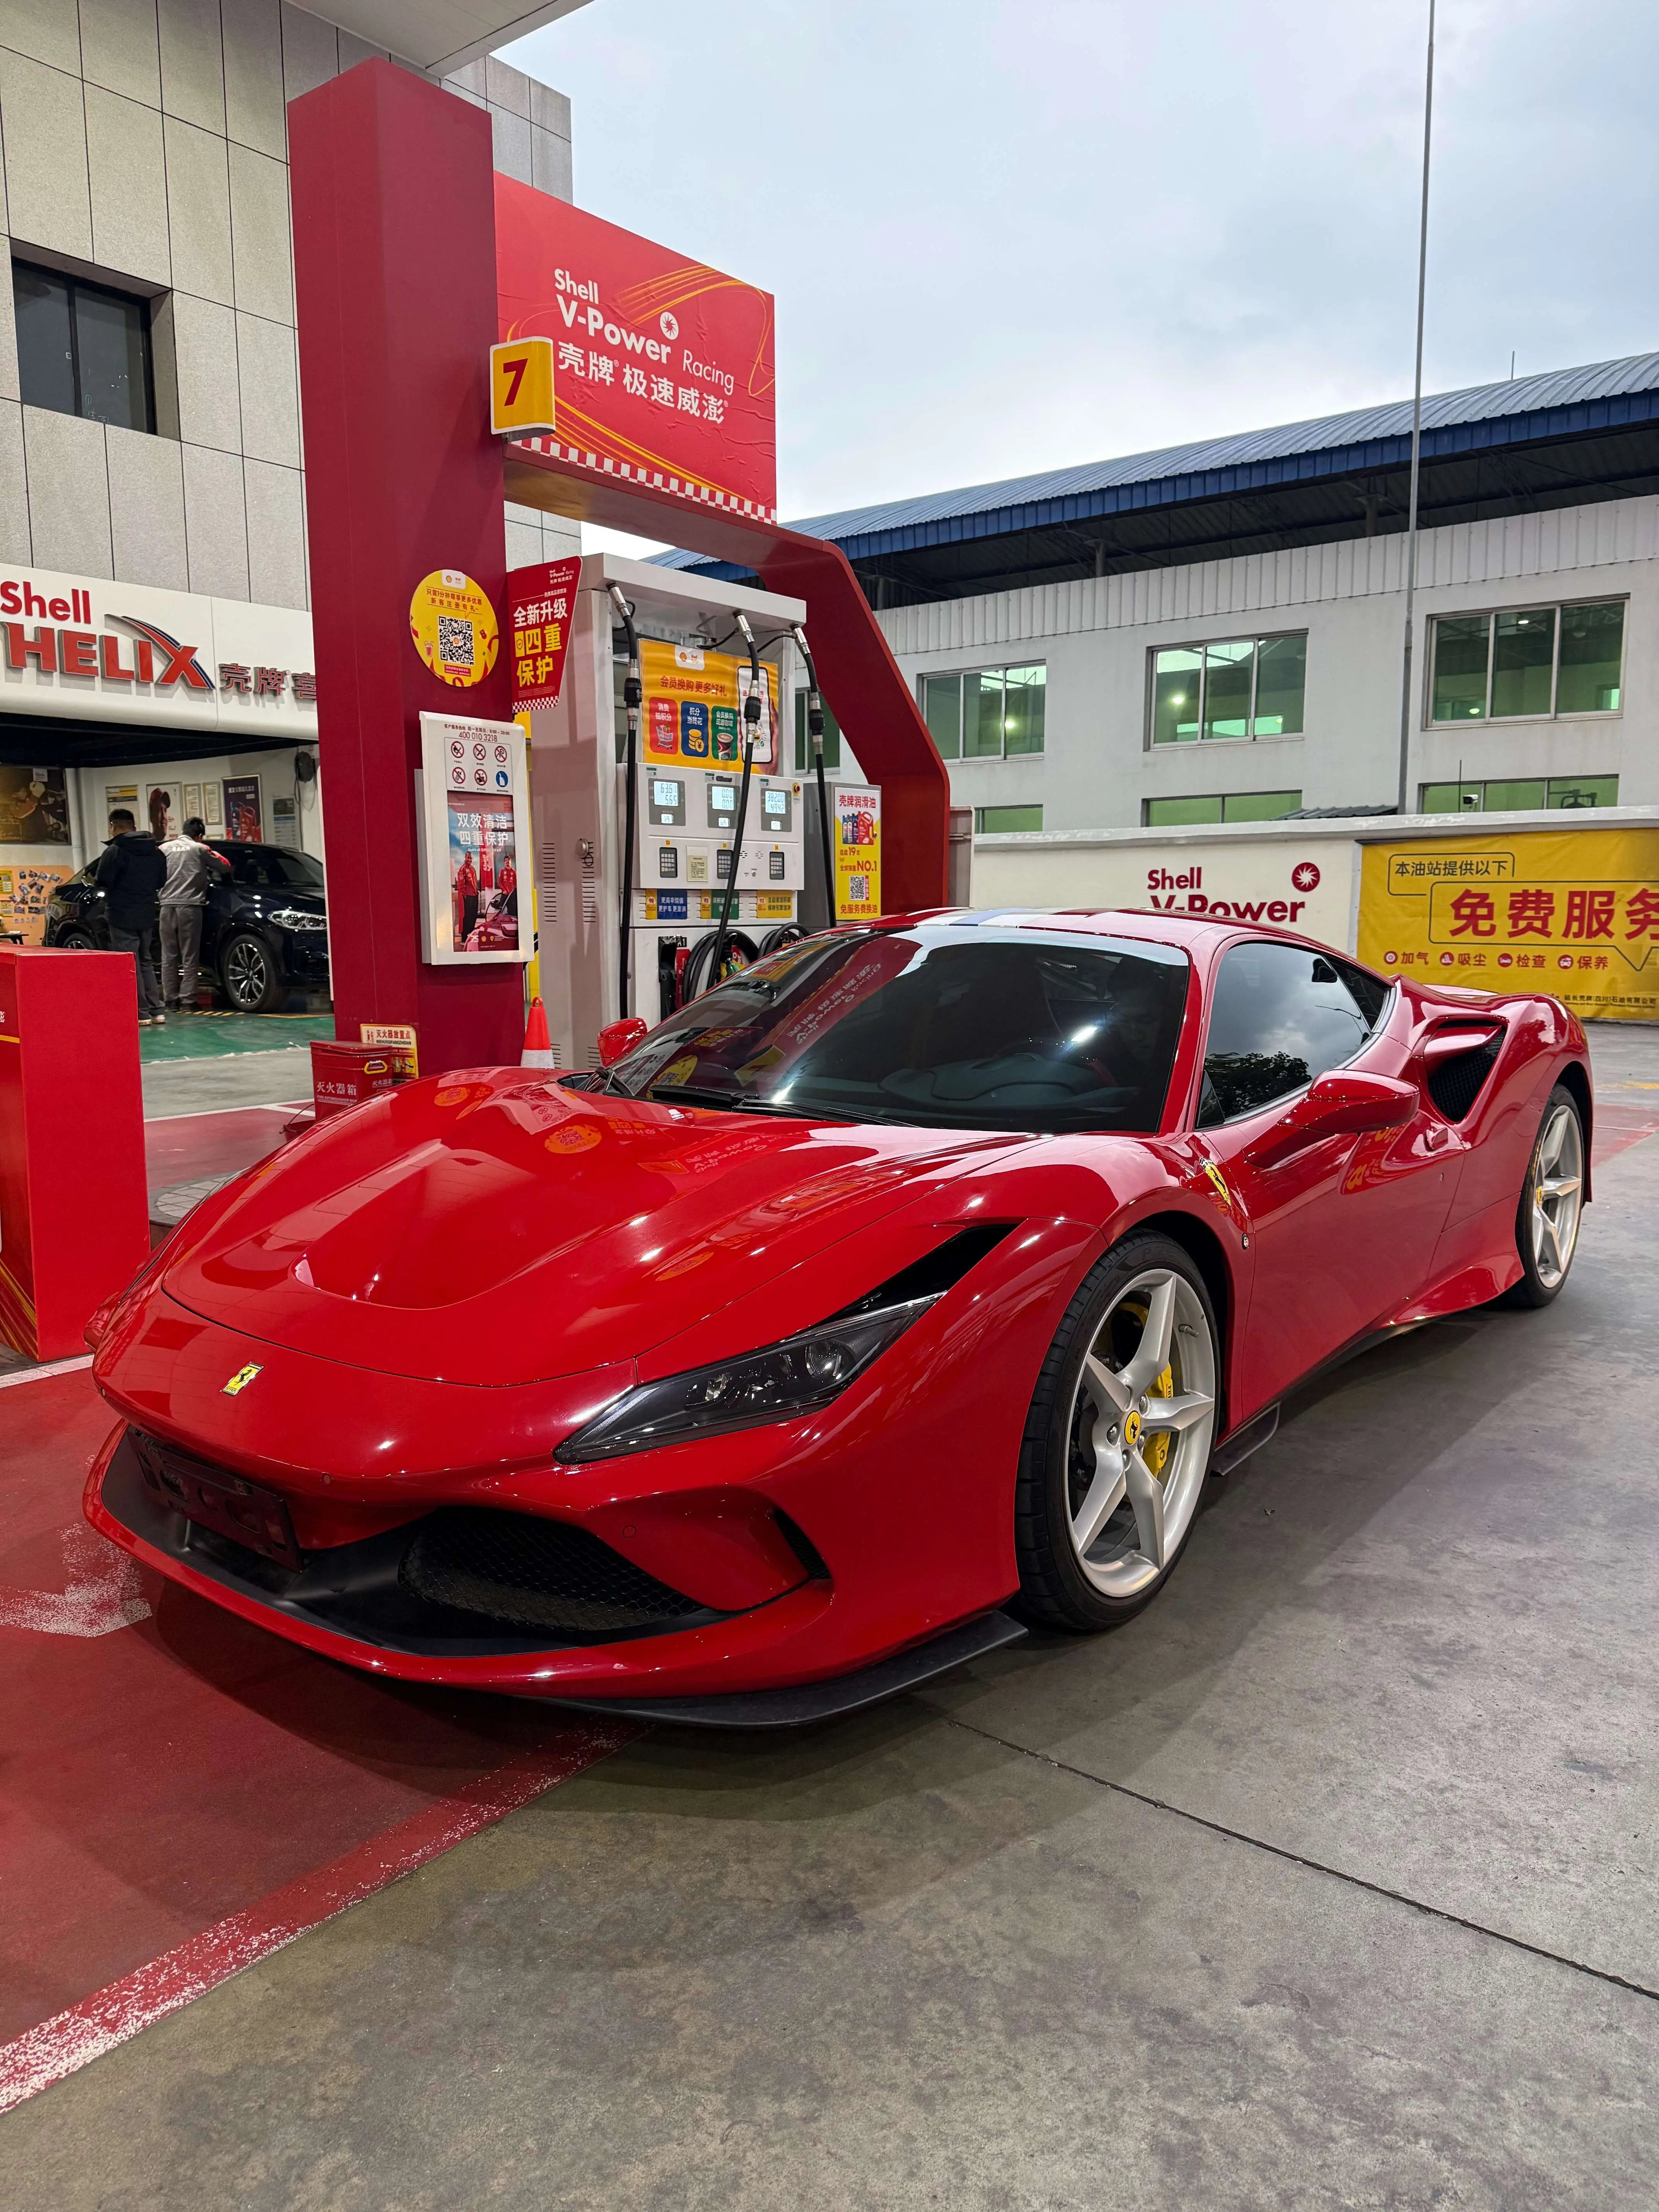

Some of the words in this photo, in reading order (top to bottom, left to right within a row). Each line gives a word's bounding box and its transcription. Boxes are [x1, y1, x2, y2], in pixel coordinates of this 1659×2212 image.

[554, 268, 598, 304] Shell
[556, 294, 672, 364] V-Power
[682, 350, 734, 395] Racing
[503, 358, 528, 406] 7
[0, 581, 91, 624] Shell
[513, 598, 568, 628] 全新升级
[526, 623, 562, 654] 四重
[2, 616, 216, 690] HELIX
[517, 656, 553, 687] 保护
[660, 675, 694, 692] 会员换购
[689, 707, 700, 716] 积分
[459, 731, 470, 739] 400
[484, 734, 498, 742] 3218
[839, 795, 876, 809] 壳牌润滑油
[457, 813, 507, 829] 双效清洁
[460, 831, 508, 846] 四重保护
[1395, 860, 1508, 877] 本油站提供以下
[1147, 867, 1202, 890] Shell
[1449, 888, 1659, 941] 免费服务
[1401, 951, 1429, 966] 加气
[1458, 952, 1487, 967] 吸尘
[1516, 954, 1546, 969] 检查
[1577, 955, 1609, 970] 保养
[376, 1029, 411, 1039] 灭火器放置点
[317, 1082, 357, 1096] 灭火器箱
